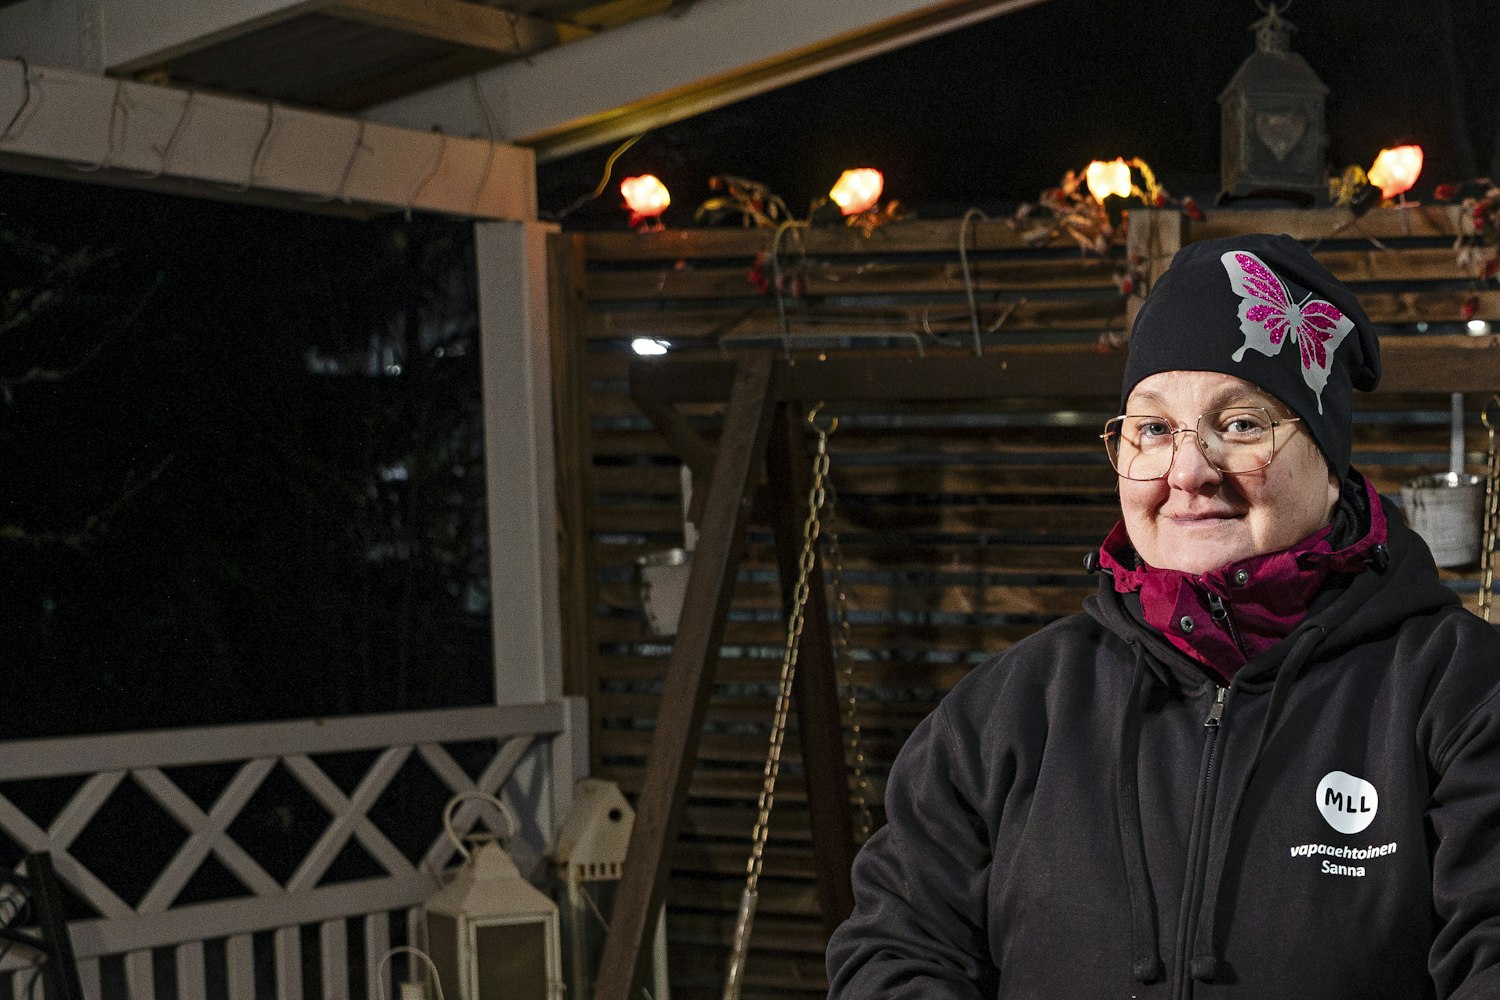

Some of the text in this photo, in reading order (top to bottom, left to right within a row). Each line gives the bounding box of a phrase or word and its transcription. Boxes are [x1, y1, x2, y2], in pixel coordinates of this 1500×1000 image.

[1324, 787, 1371, 813] MLL
[1290, 841, 1397, 860] vapaaehtoinen
[1321, 860, 1366, 877] Sanna
